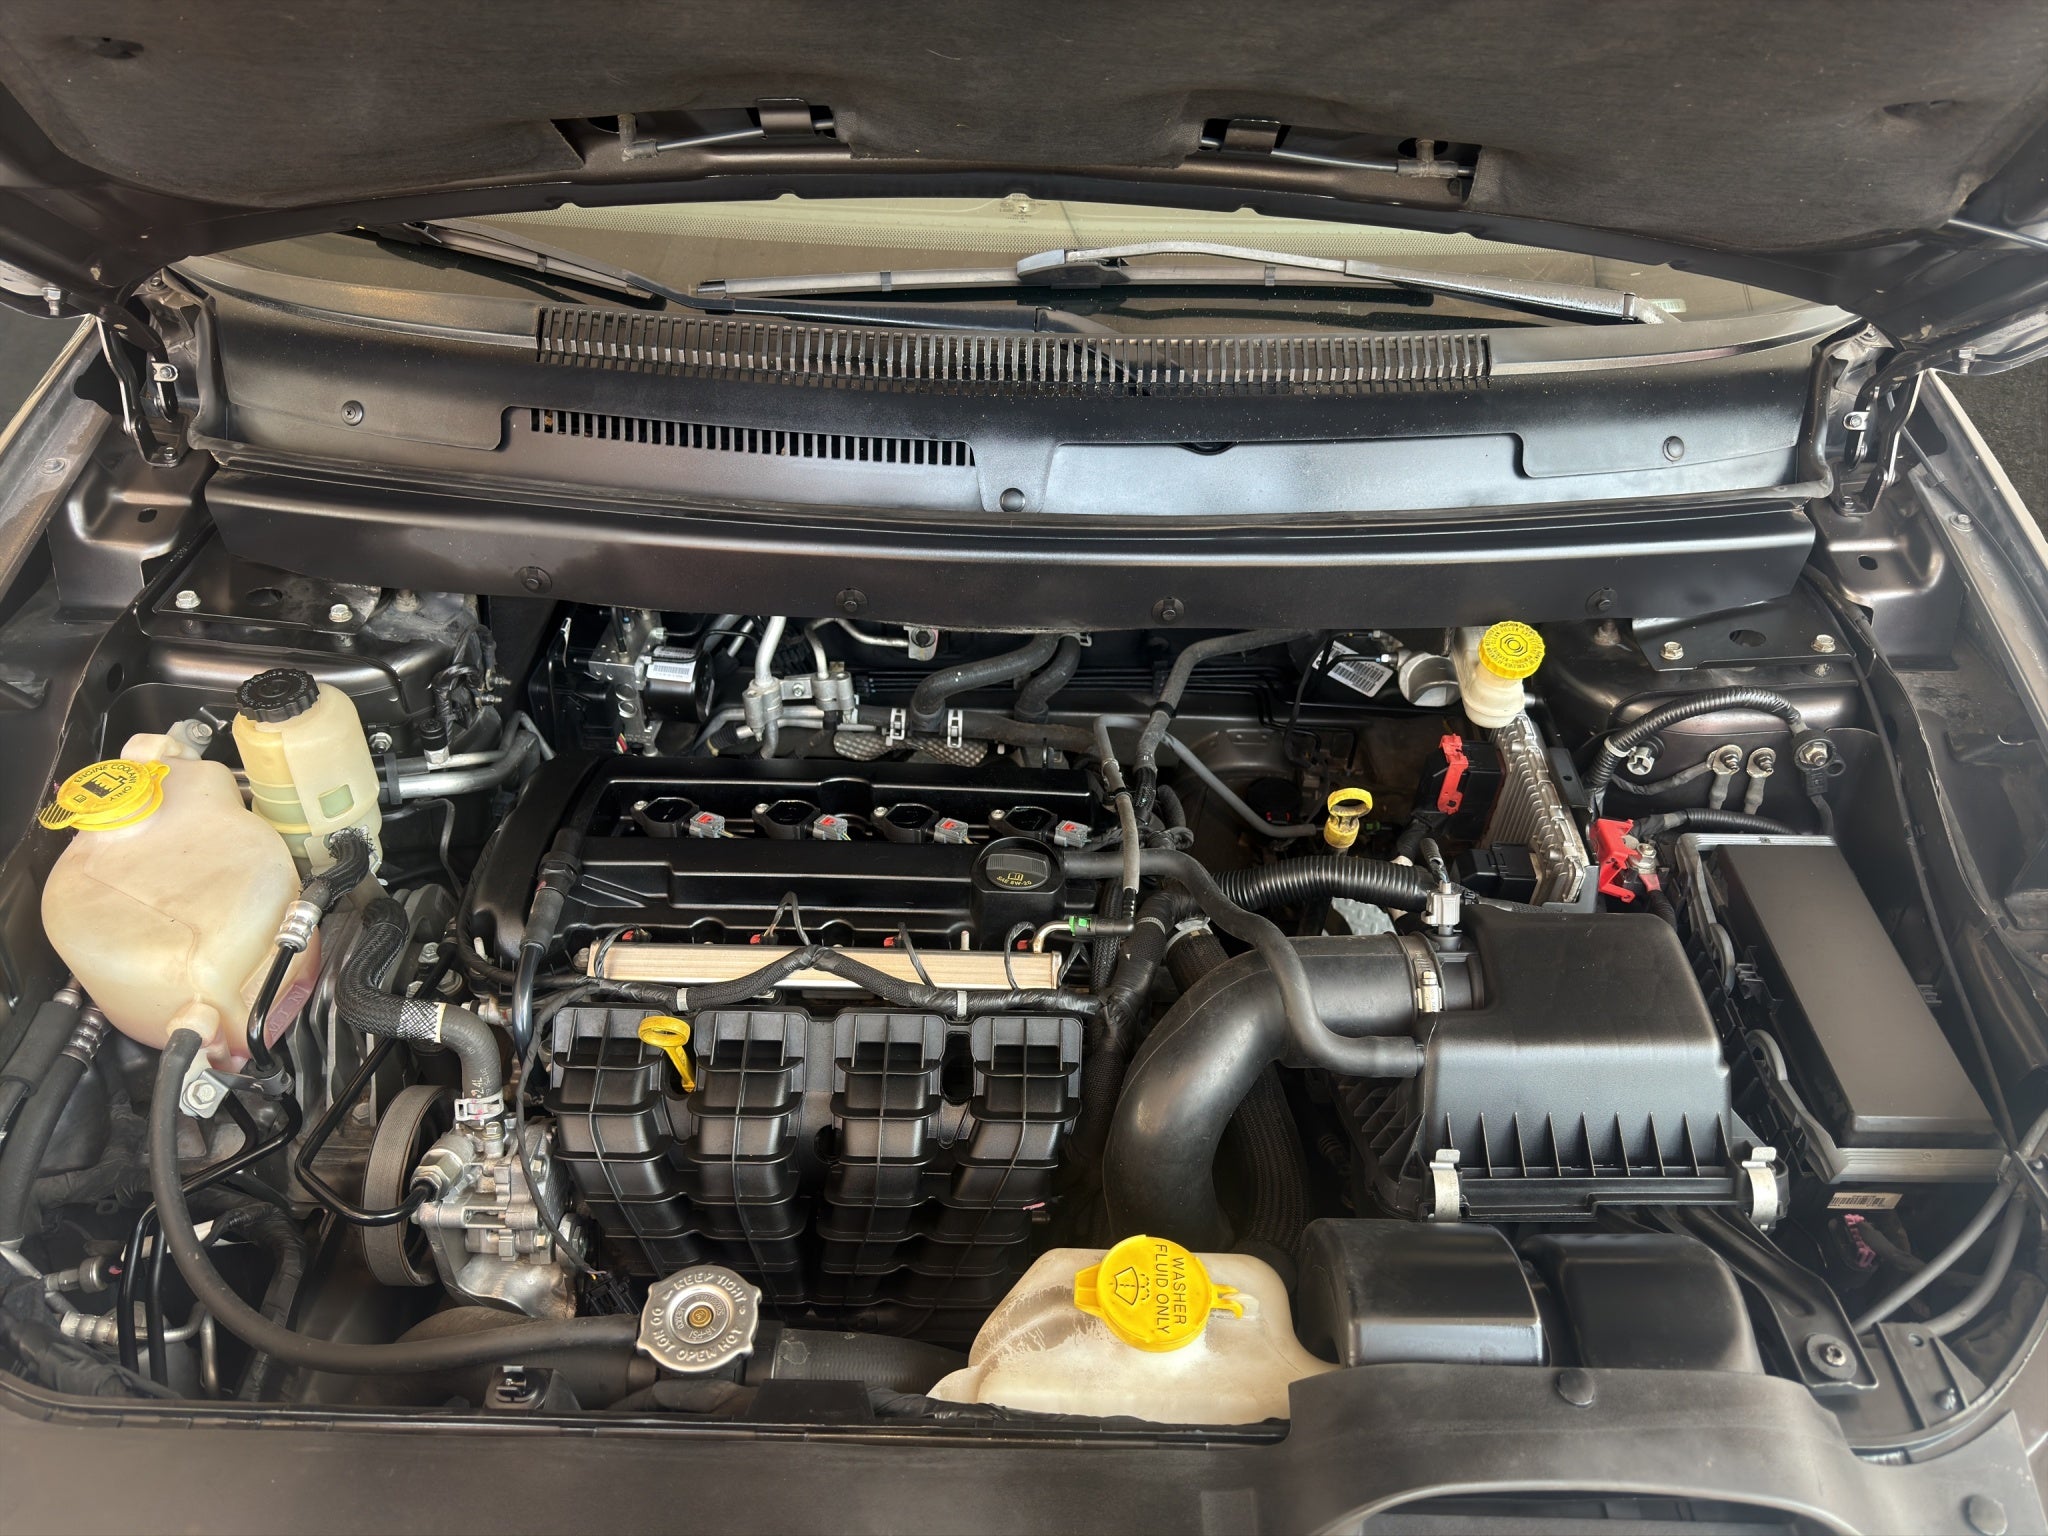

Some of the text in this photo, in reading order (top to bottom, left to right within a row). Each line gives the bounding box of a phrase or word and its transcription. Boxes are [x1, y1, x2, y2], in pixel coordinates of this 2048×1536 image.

[74, 764, 137, 802] ENGINE COOLANT ONLY
[673, 1273, 747, 1302] KEEP TIGHT
[1155, 1244, 1171, 1334] FLUID ONLY
[1172, 1257, 1187, 1325] WASHER
[650, 1308, 664, 1326] DO
[652, 1329, 675, 1353] NOT
[718, 1328, 743, 1352] HOT
[676, 1347, 717, 1362] OPEN
